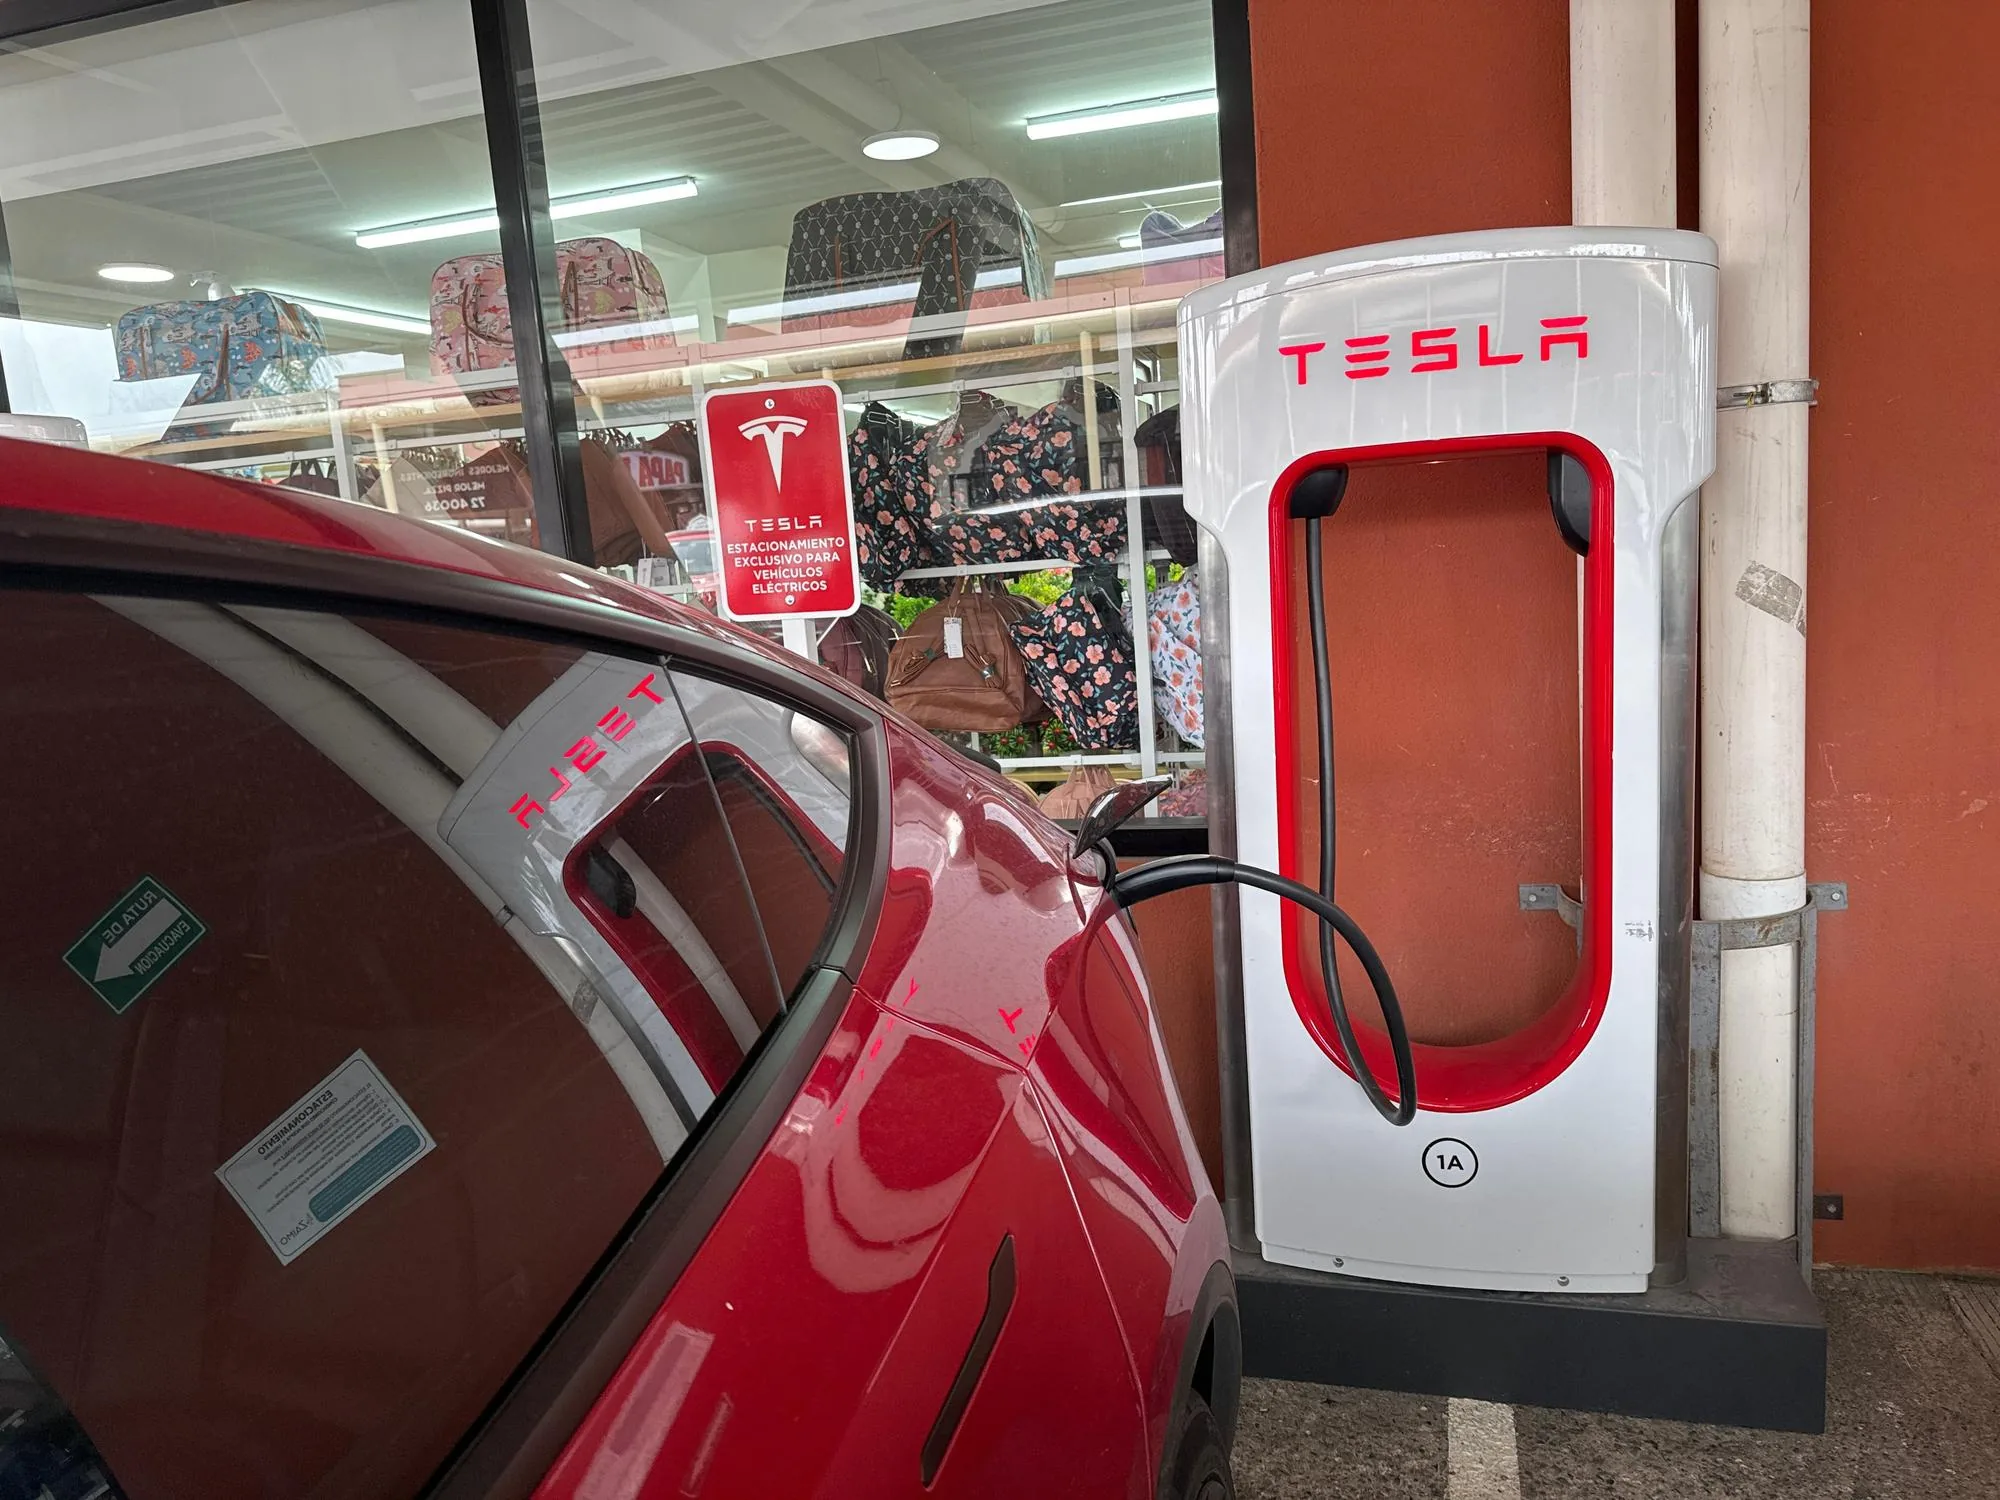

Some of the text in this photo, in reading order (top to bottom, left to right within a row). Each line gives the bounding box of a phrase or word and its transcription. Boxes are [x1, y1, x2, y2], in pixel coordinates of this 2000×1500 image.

[1278, 315, 1588, 386] TESLA
[745, 516, 823, 531] TESLA
[727, 536, 845, 555] ESTACIONAMIENTO
[734, 550, 841, 568] EXCLUSIVO PARA
[753, 564, 823, 581] VEHÍCULOS
[753, 580, 827, 595] ELÉCTRICOS
[1436, 1154, 1465, 1171] 1A
